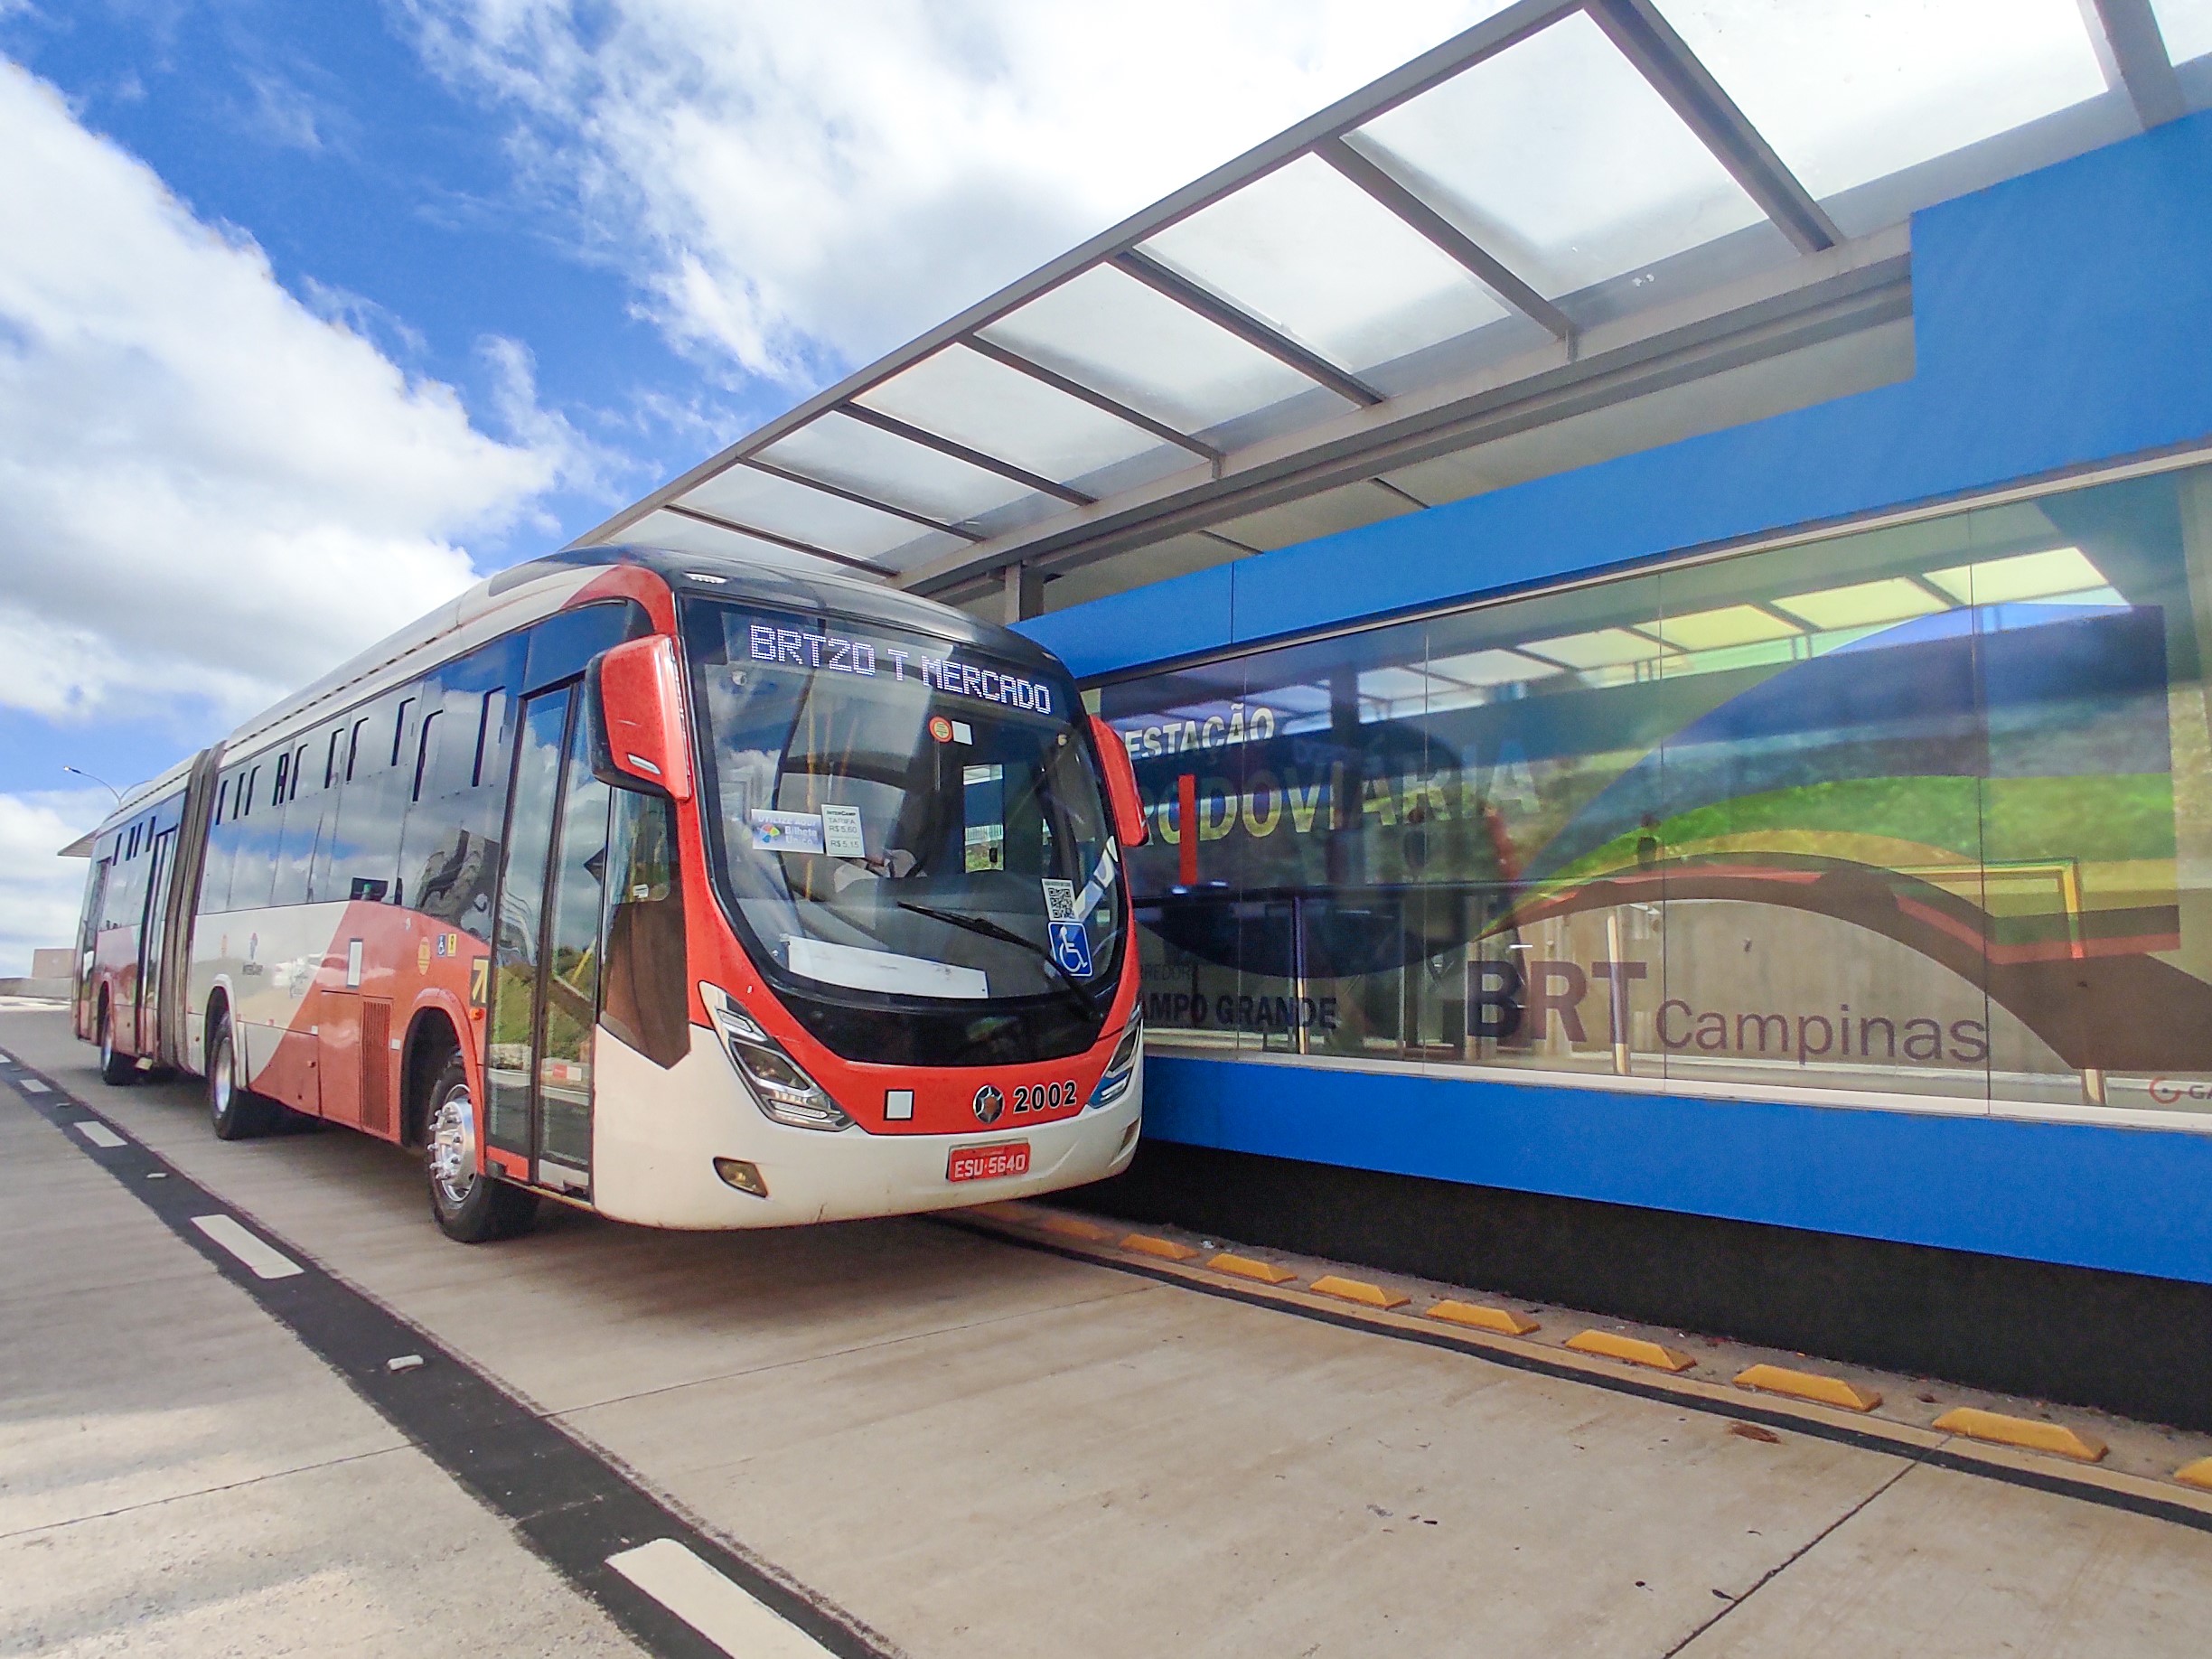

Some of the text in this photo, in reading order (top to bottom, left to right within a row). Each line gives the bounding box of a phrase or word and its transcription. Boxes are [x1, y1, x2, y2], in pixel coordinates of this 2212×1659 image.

[887, 649, 908, 681] T
[922, 655, 1051, 715] MERCADO
[1125, 703, 1275, 762] ESTAÇÃO
[784, 825, 818, 837] Bilhete
[828, 817, 857, 825] TARIFA
[1216, 995, 1337, 1029] GRANDE
[1467, 961, 1988, 1065] BRT Campinas
[1013, 1080, 1077, 1114] 2002
